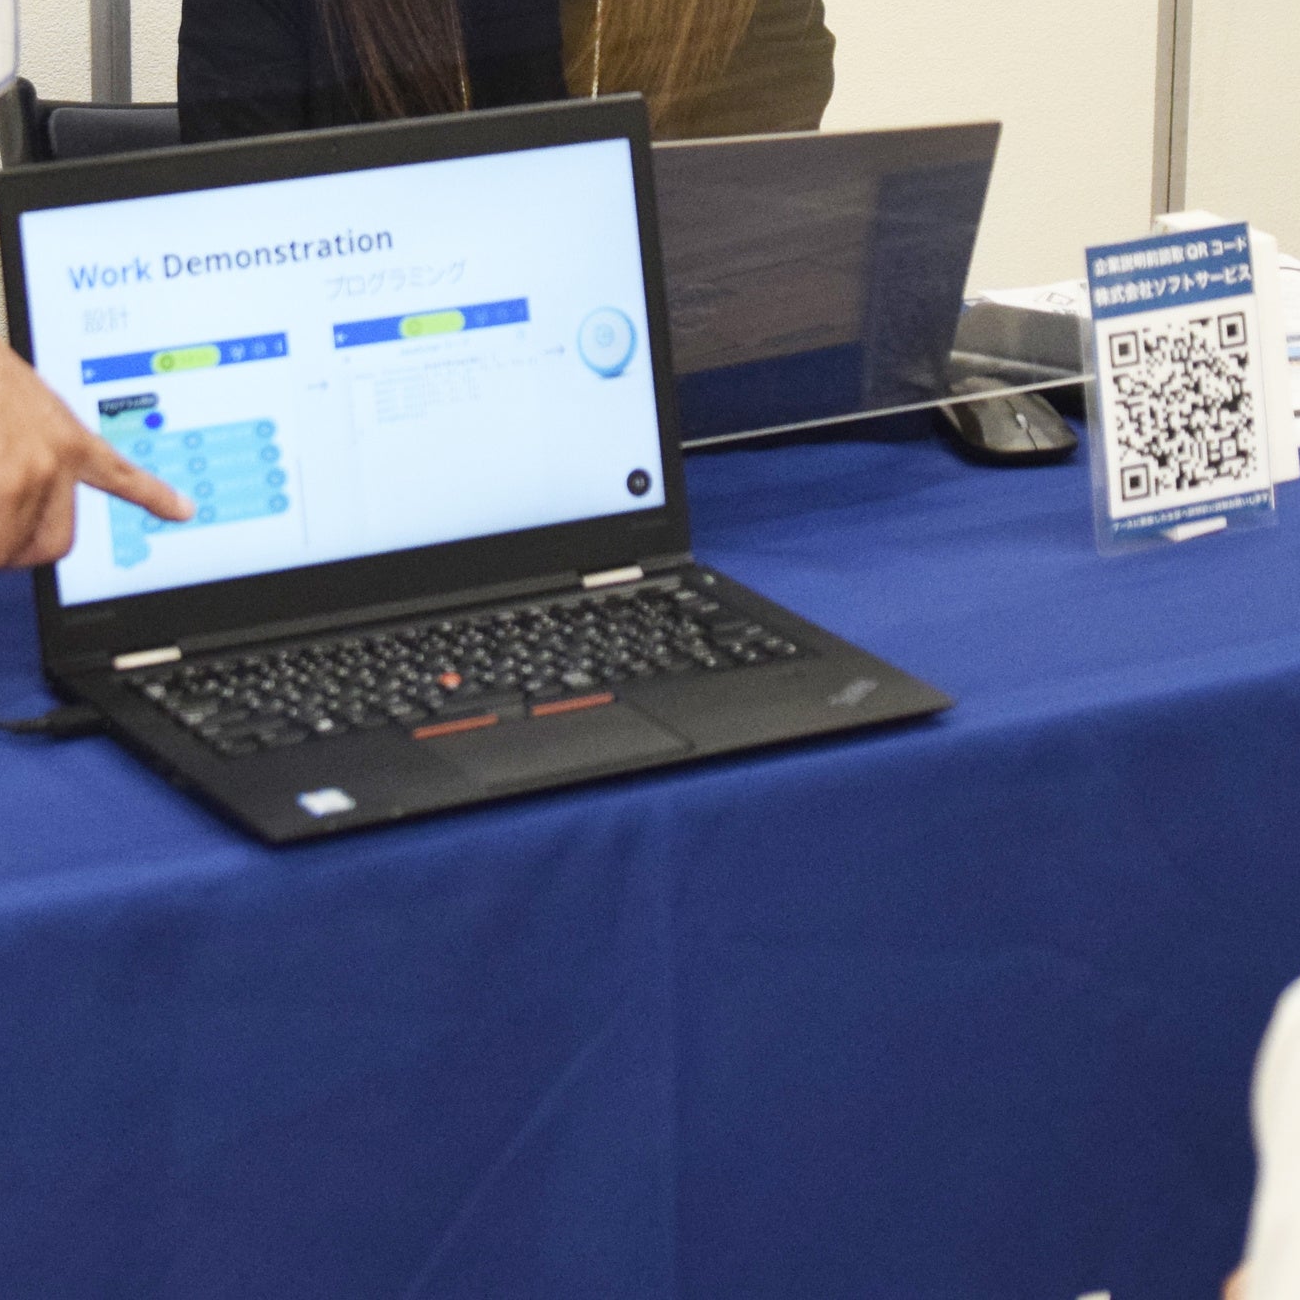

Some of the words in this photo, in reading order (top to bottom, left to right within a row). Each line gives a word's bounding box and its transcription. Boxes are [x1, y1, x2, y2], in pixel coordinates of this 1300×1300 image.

[68, 256, 152, 291] Work
[163, 229, 394, 279] Demonstration
[325, 260, 466, 300] プログラミング
